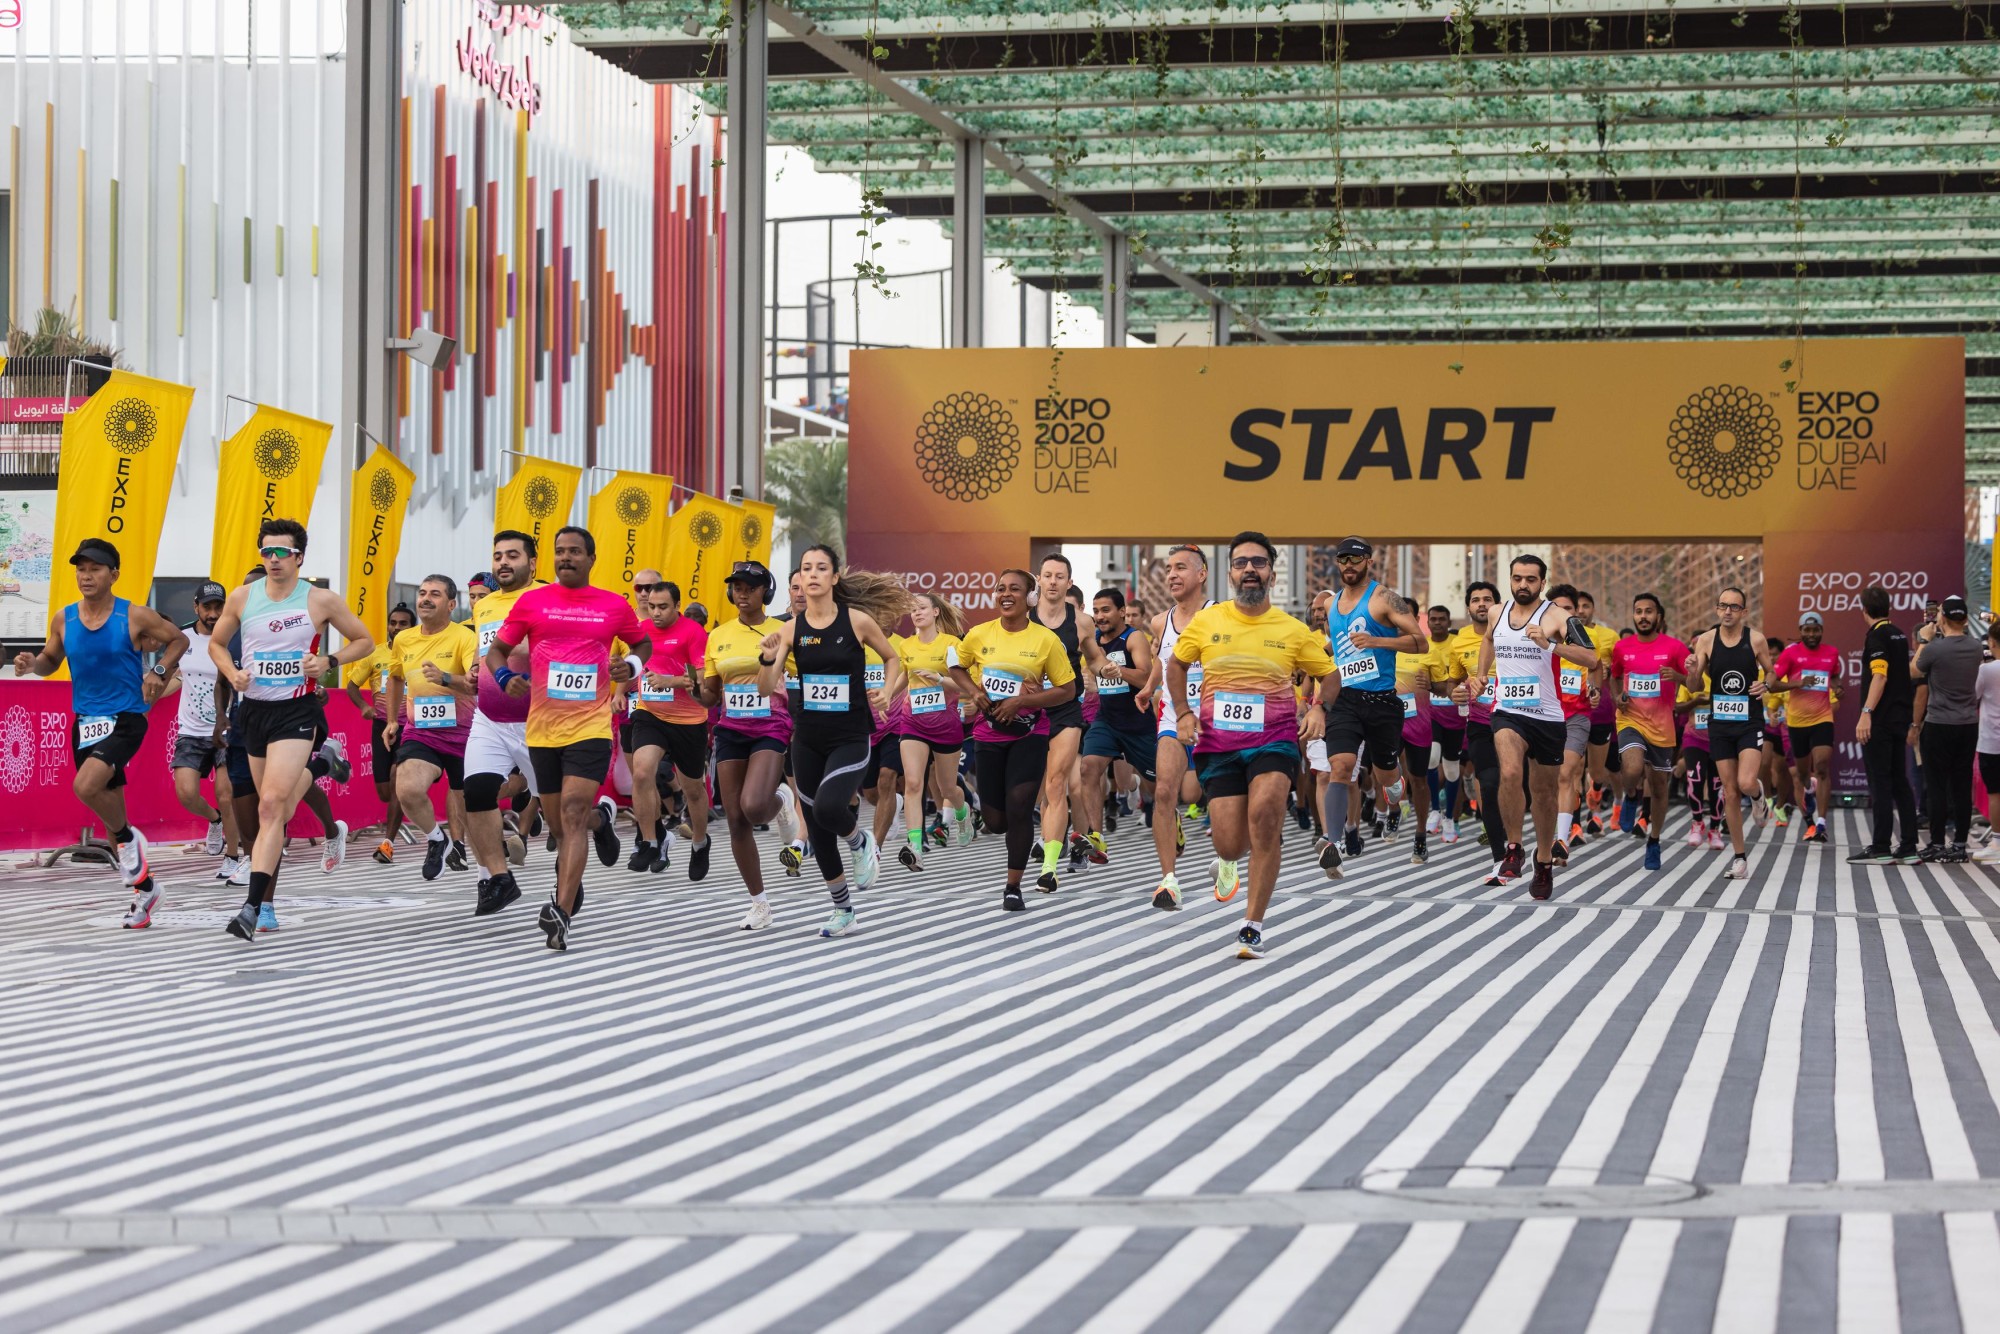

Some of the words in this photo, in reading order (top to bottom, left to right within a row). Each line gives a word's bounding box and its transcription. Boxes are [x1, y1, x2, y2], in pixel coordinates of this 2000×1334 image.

[1034, 398, 1110, 420] EXPO
[1798, 391, 1879, 414] EXPO
[1034, 422, 1105, 445] 2020
[1797, 416, 1873, 440] 2020
[1223, 406, 1556, 482] START
[1034, 446, 1117, 469] DUBAI
[1797, 441, 1886, 465] DUBAI
[1034, 471, 1090, 493] UAE
[1797, 467, 1857, 490] UAE
[107, 458, 131, 533] EXPO
[363, 514, 385, 576] EXPO
[622, 529, 636, 582] EXPO
[886, 572, 937, 589] XPO
[940, 572, 997, 589] 2020
[1798, 572, 1862, 590] EXPO
[1866, 571, 1928, 590] 2020
[357, 586, 367, 616] 20
[949, 592, 996, 609] RUN
[1799, 593, 1863, 611] DUBA
[1888, 593, 1929, 610] UN
[483, 631, 496, 645] 33
[1513, 652, 1542, 660] Athletics
[258, 661, 300, 676] 16805
[1342, 658, 1374, 677] 16095
[556, 673, 592, 689] 1067
[985, 677, 1016, 694] 4095
[1561, 676, 1575, 686] 84
[1632, 680, 1656, 690] 1580
[812, 685, 838, 700] 234
[915, 693, 940, 705] 4797
[1504, 685, 1534, 697] 3854
[730, 694, 762, 707] 4121
[1717, 703, 1743, 712] 4640
[422, 705, 446, 718] 939
[1223, 703, 1252, 720] 888
[40, 711, 67, 730] EXPO
[84, 722, 109, 739] 3383
[40, 731, 65, 748] 2020
[40, 749, 68, 768] DUBAI
[361, 743, 372, 759] EXP
[361, 761, 373, 776] DUB
[40, 768, 59, 787] UAE
